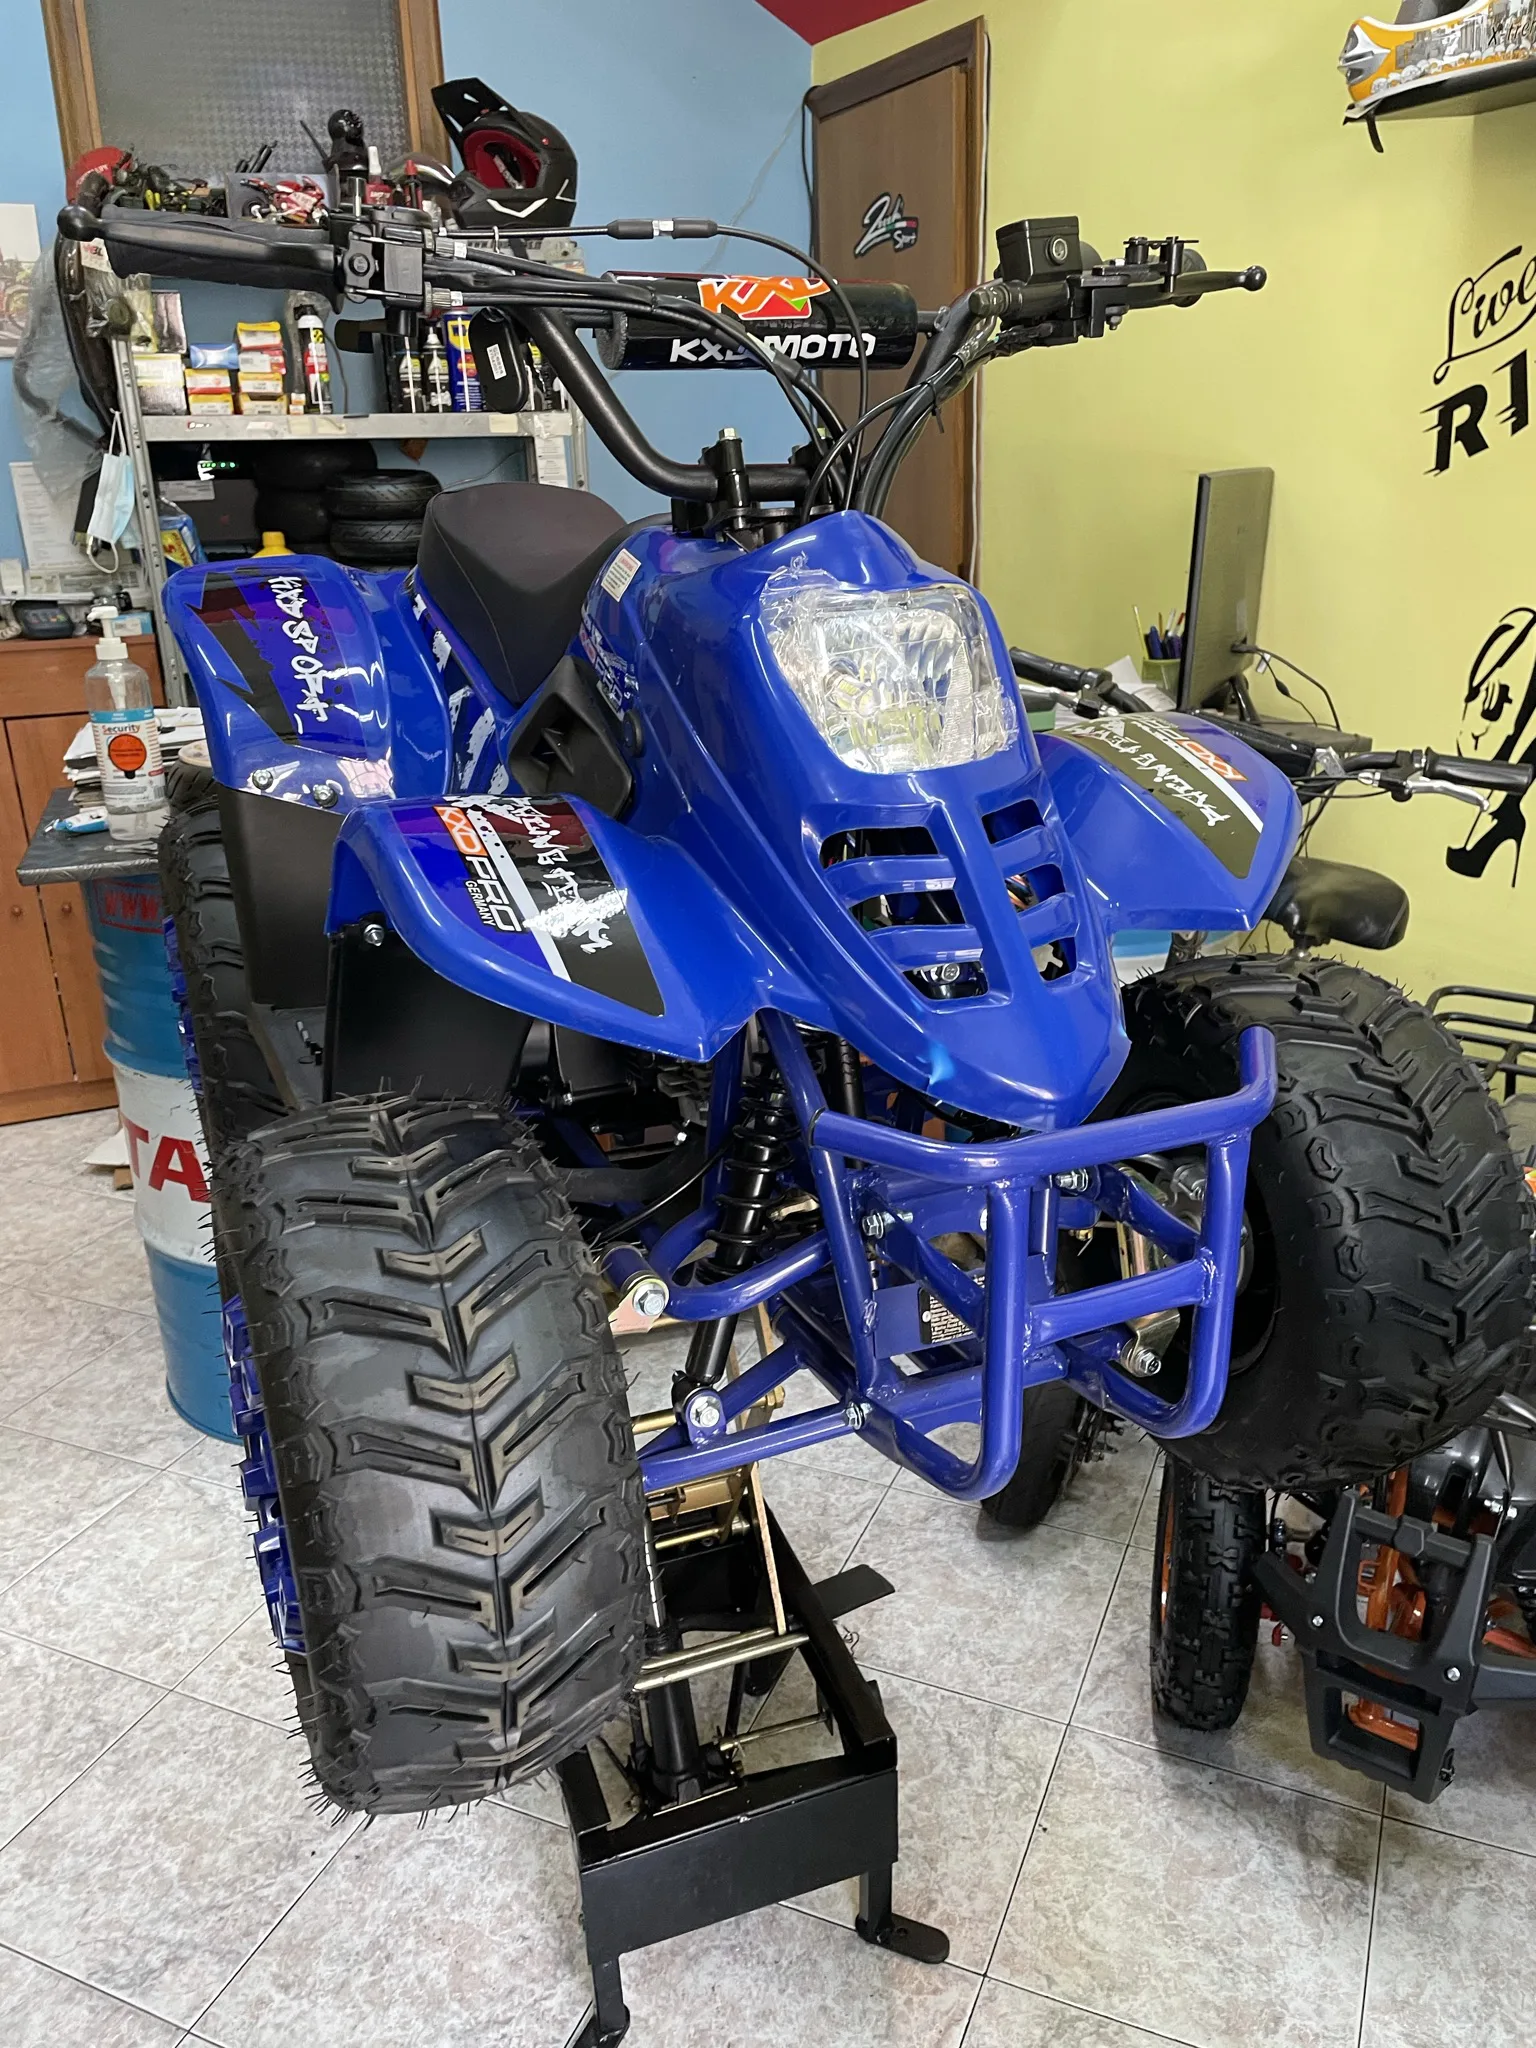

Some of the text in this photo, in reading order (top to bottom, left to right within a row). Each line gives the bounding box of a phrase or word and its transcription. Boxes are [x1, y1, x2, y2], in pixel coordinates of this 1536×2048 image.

[763, 333, 876, 360] MOTO
[101, 724, 140, 735] Security
[1181, 739, 1247, 782] KXD
[435, 806, 523, 932] KXD PRO
[464, 880, 496, 926] GERMANY
